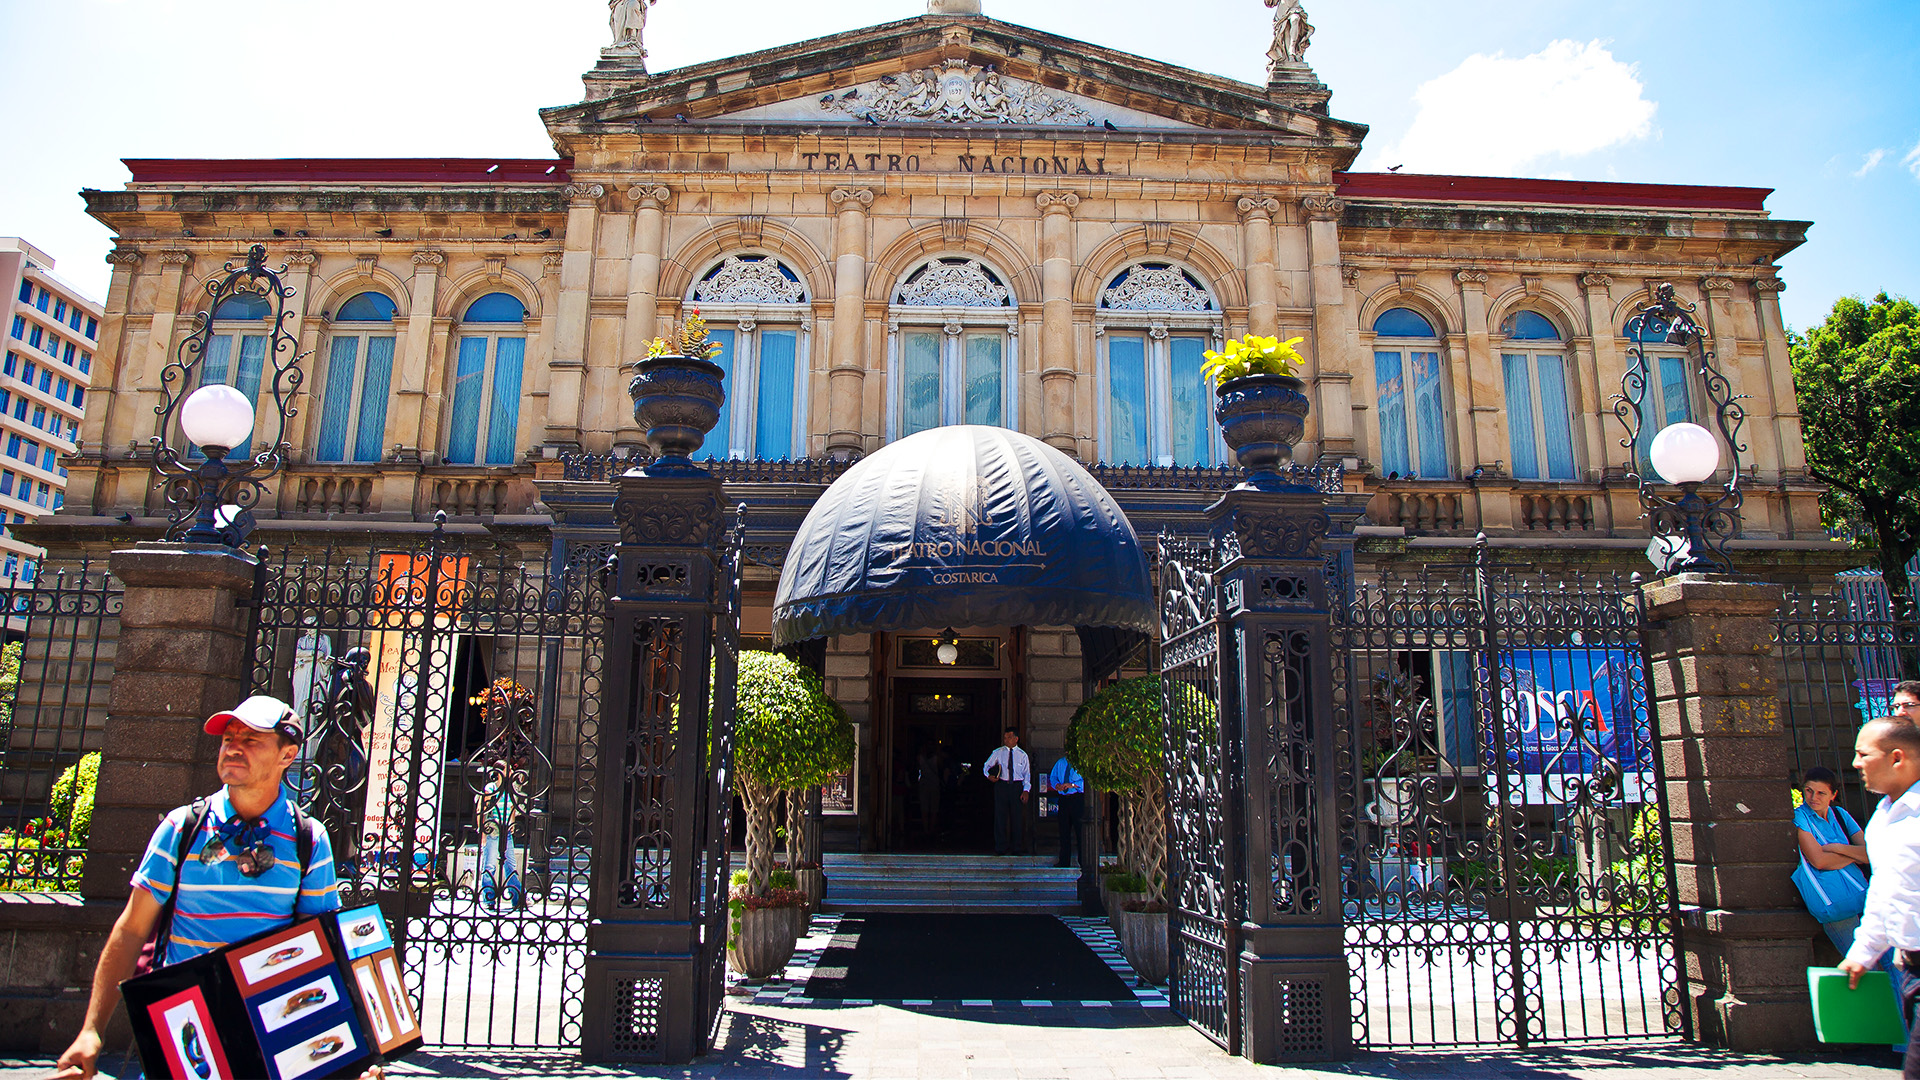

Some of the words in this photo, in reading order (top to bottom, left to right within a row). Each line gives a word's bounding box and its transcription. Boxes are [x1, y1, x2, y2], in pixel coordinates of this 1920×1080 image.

[802, 152, 920, 172] TEATRO
[958, 154, 1112, 176] NACIONAL
[891, 540, 954, 559] TEATRO
[956, 540, 1047, 557] NACIONAL
